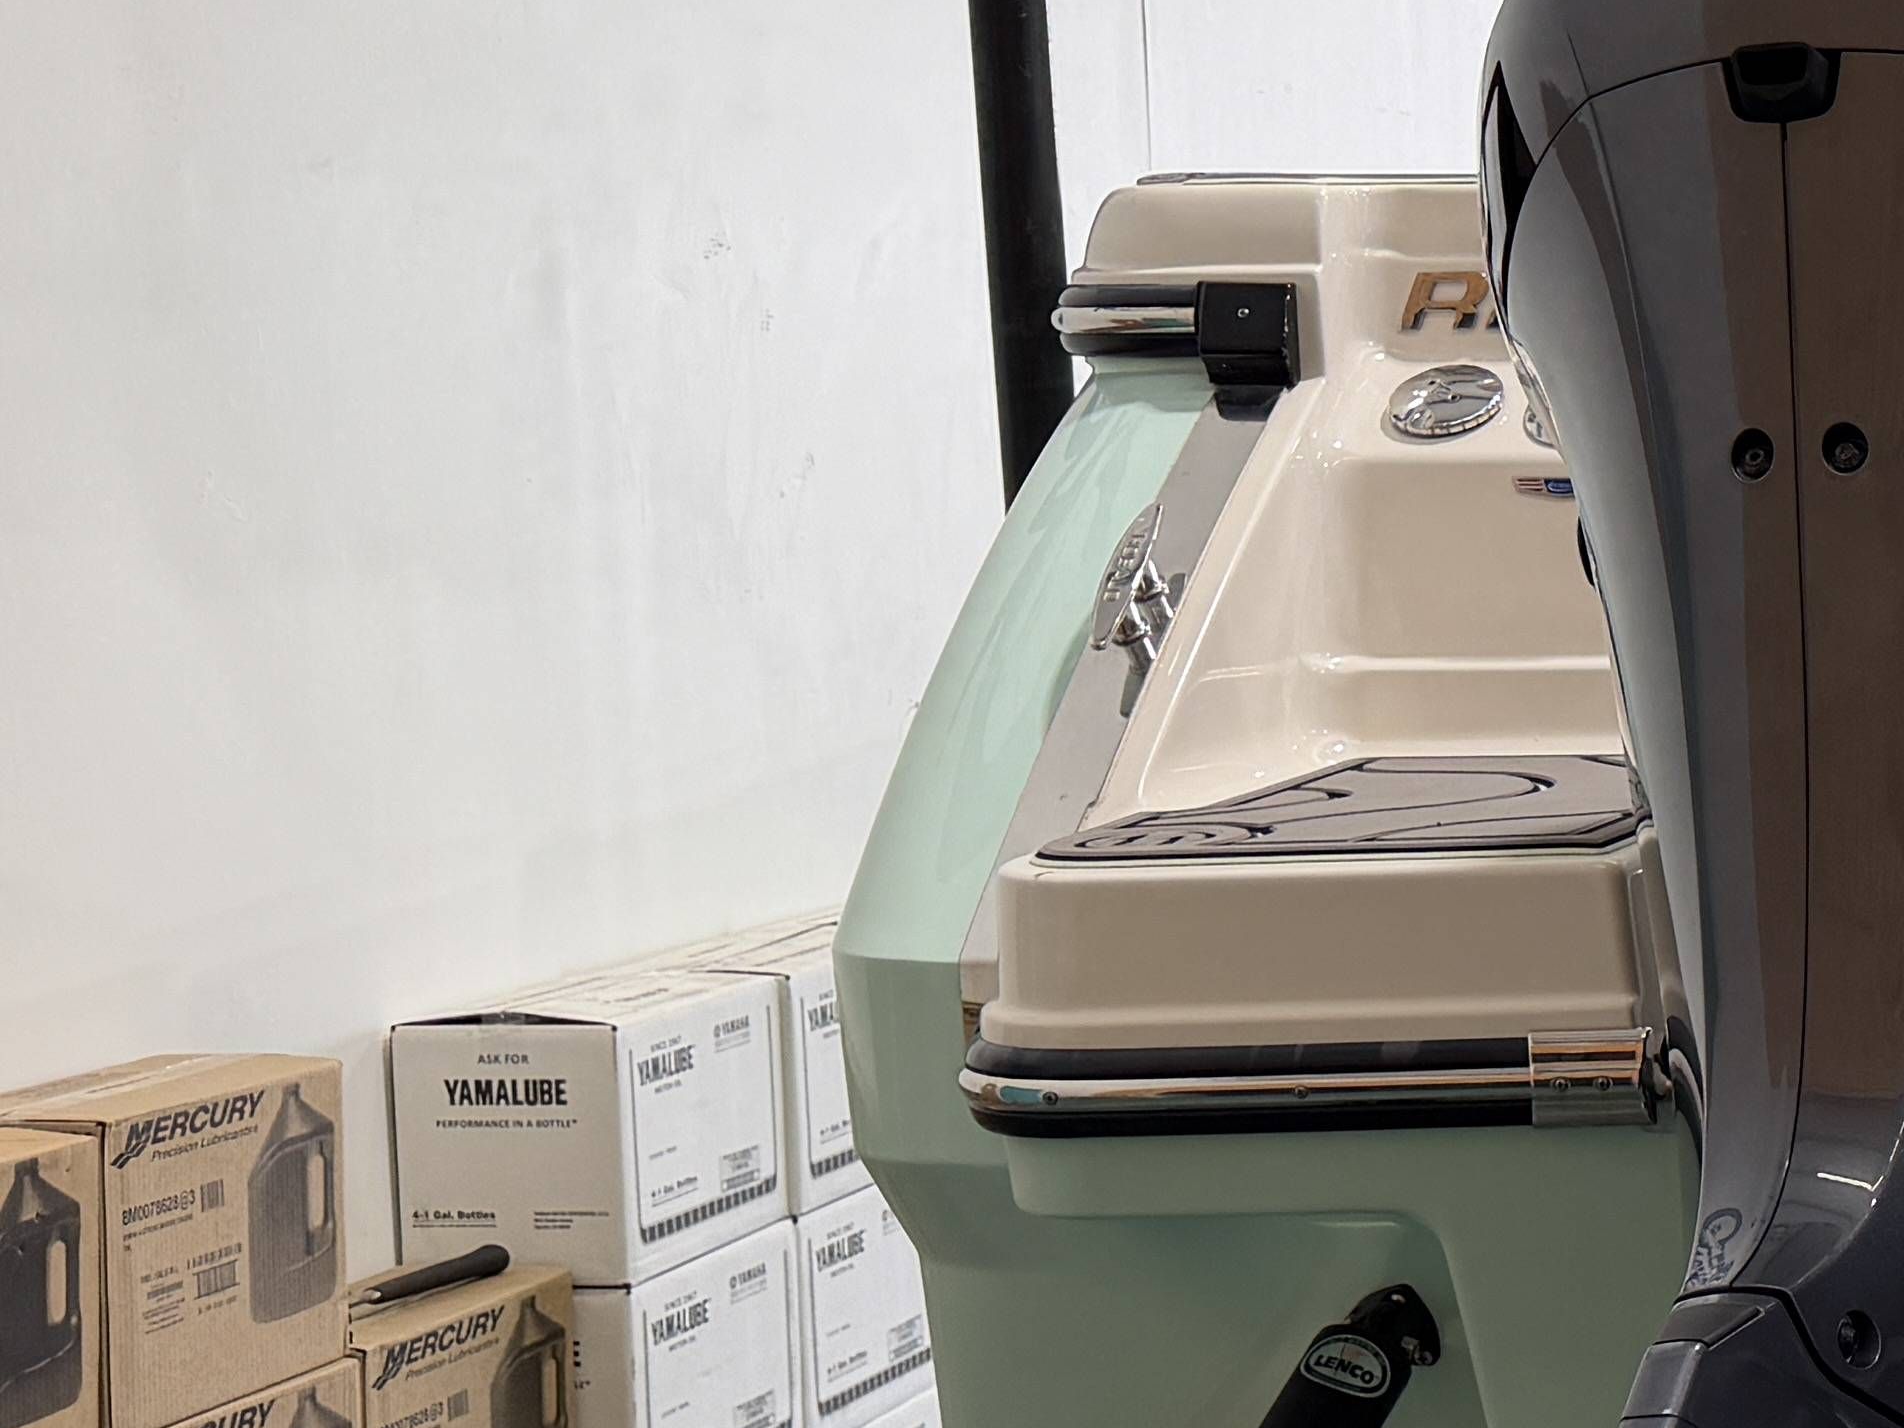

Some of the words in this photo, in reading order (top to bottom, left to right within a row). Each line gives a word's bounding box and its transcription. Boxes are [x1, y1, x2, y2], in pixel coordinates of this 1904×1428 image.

[478, 1054, 501, 1065] ASK
[505, 1053, 529, 1064] FOR
[637, 1044, 695, 1086] YAMALUBE
[443, 1079, 568, 1106] YAMALUBE
[111, 1090, 265, 1169] MERCURY
[436, 1119, 510, 1128] PERFORMANCE
[513, 1120, 523, 1128] IN
[526, 1120, 533, 1128] A
[151, 1139, 199, 1163] Precision
[200, 1125, 259, 1149] Lubricants
[412, 1210, 430, 1219] 4-1
[433, 1210, 455, 1219] Gal.
[458, 1210, 496, 1220] Bottles
[650, 1299, 710, 1346] YAMALUBE
[372, 1305, 505, 1390] MERCURY
[1313, 1354, 1375, 1385] LENCO
